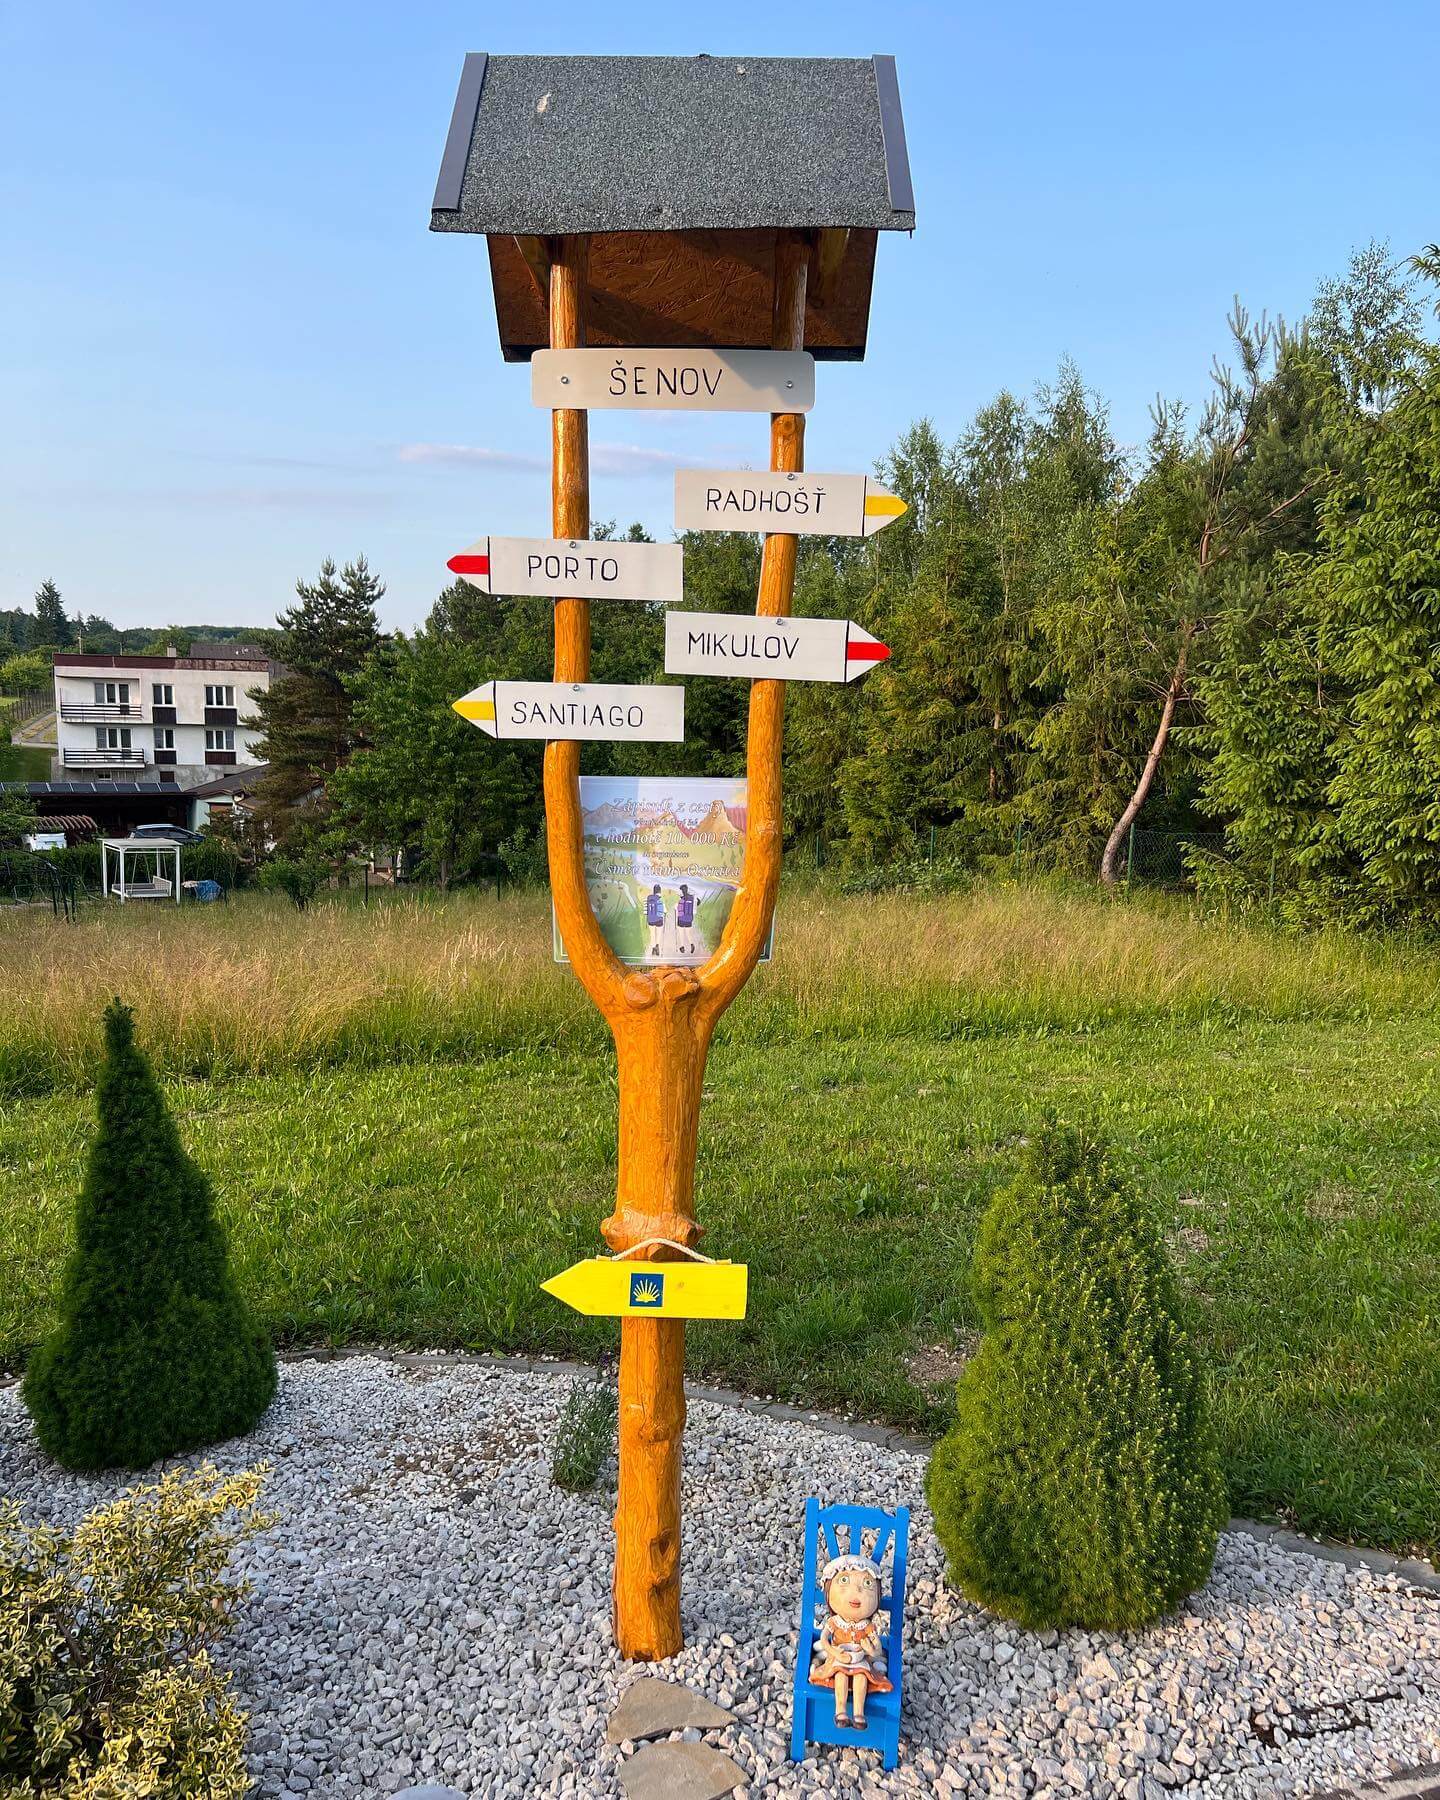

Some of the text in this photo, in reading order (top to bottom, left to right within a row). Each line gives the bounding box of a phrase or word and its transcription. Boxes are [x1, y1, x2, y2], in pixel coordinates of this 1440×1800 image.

[608, 359, 723, 397] ŠENOV
[706, 486, 827, 515] RADHOŠŤ
[527, 554, 619, 582] PORTO
[687, 632, 800, 661] MIKULOV
[510, 700, 644, 728] SANTIAGO
